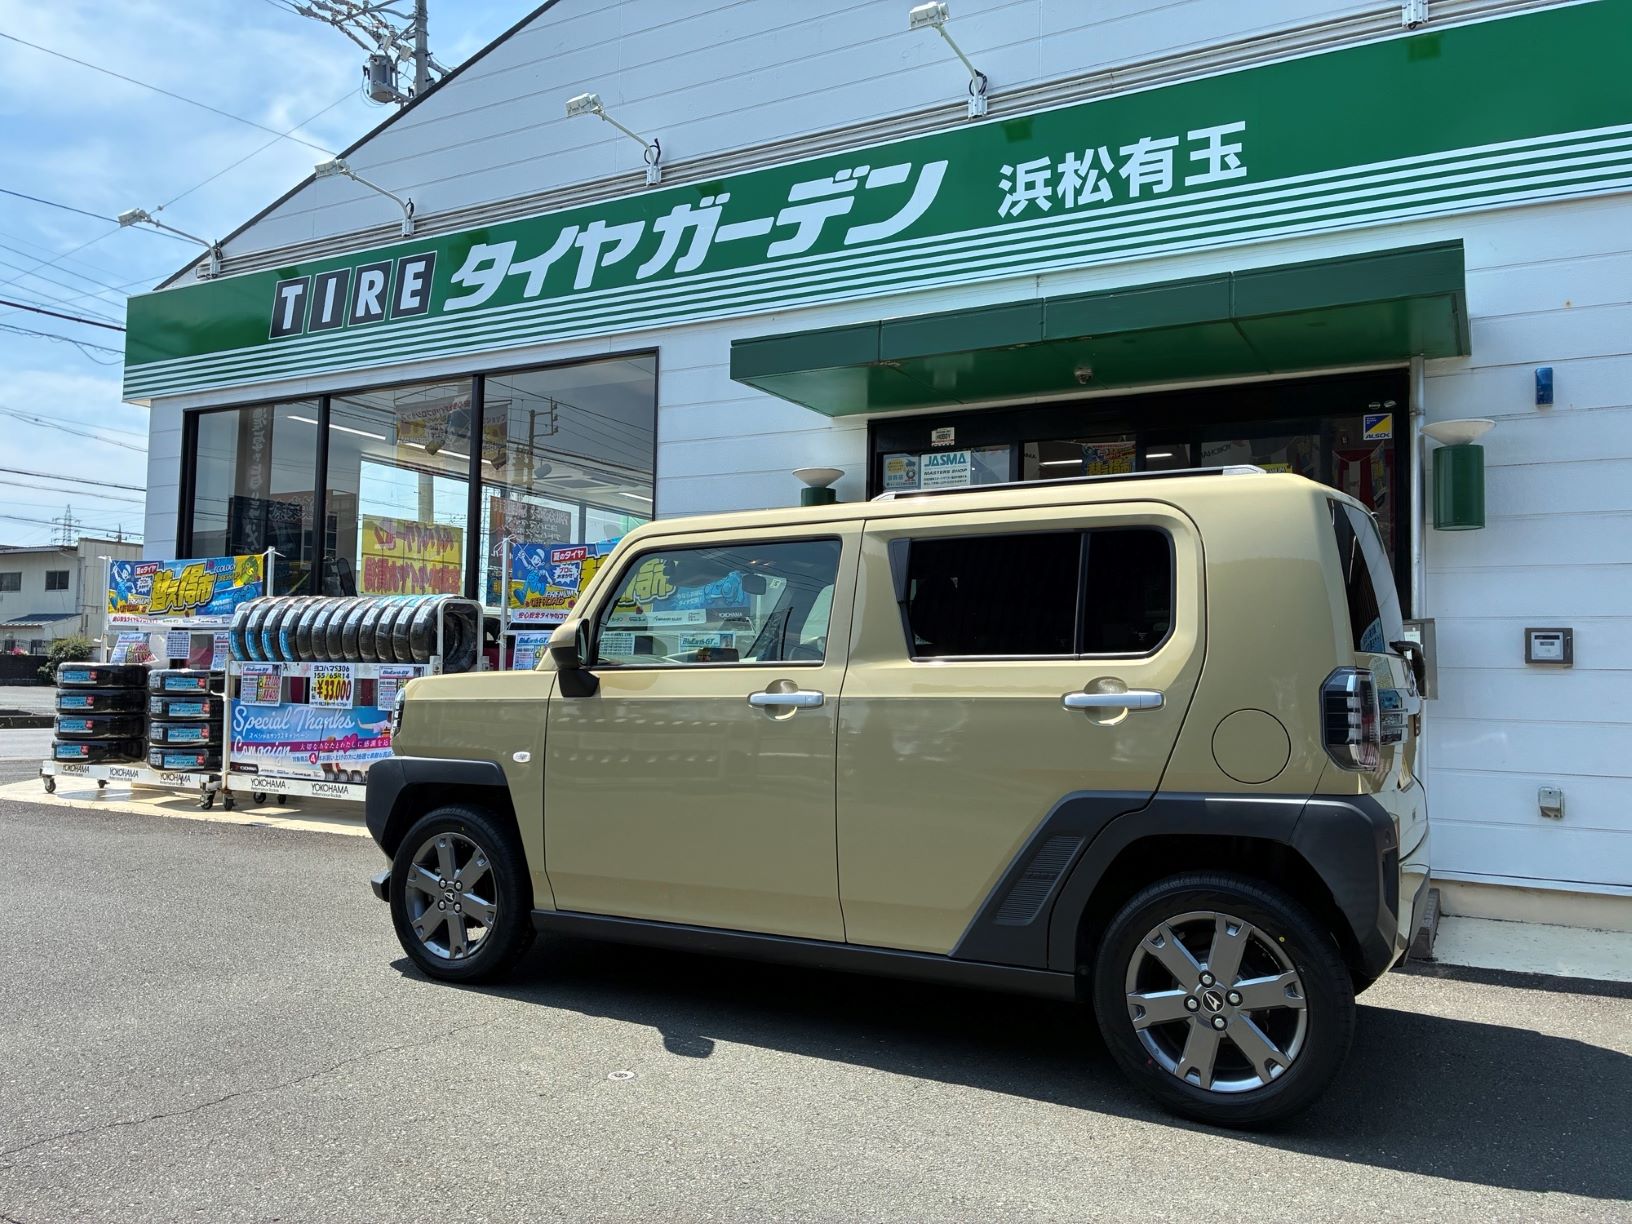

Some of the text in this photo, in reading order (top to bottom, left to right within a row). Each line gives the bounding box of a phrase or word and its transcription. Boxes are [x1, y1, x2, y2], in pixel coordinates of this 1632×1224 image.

[442, 120, 1247, 312] タイヤガーデン 浜松有玉
[281, 260, 426, 330] TIRE
[924, 453, 967, 467] JASMA
[552, 550, 584, 560] 夏のタイヤ
[317, 679, 352, 701] ¥33,000
[233, 705, 290, 736] Special
[294, 707, 355, 729] Thanks
[62, 764, 90, 774] YOKOHAMA
[109, 767, 139, 778] YOKOHAMA
[160, 773, 191, 783] YOKOHAMA
[250, 778, 286, 789] YOKOHAMA
[311, 783, 349, 794] YOKOHAMA
